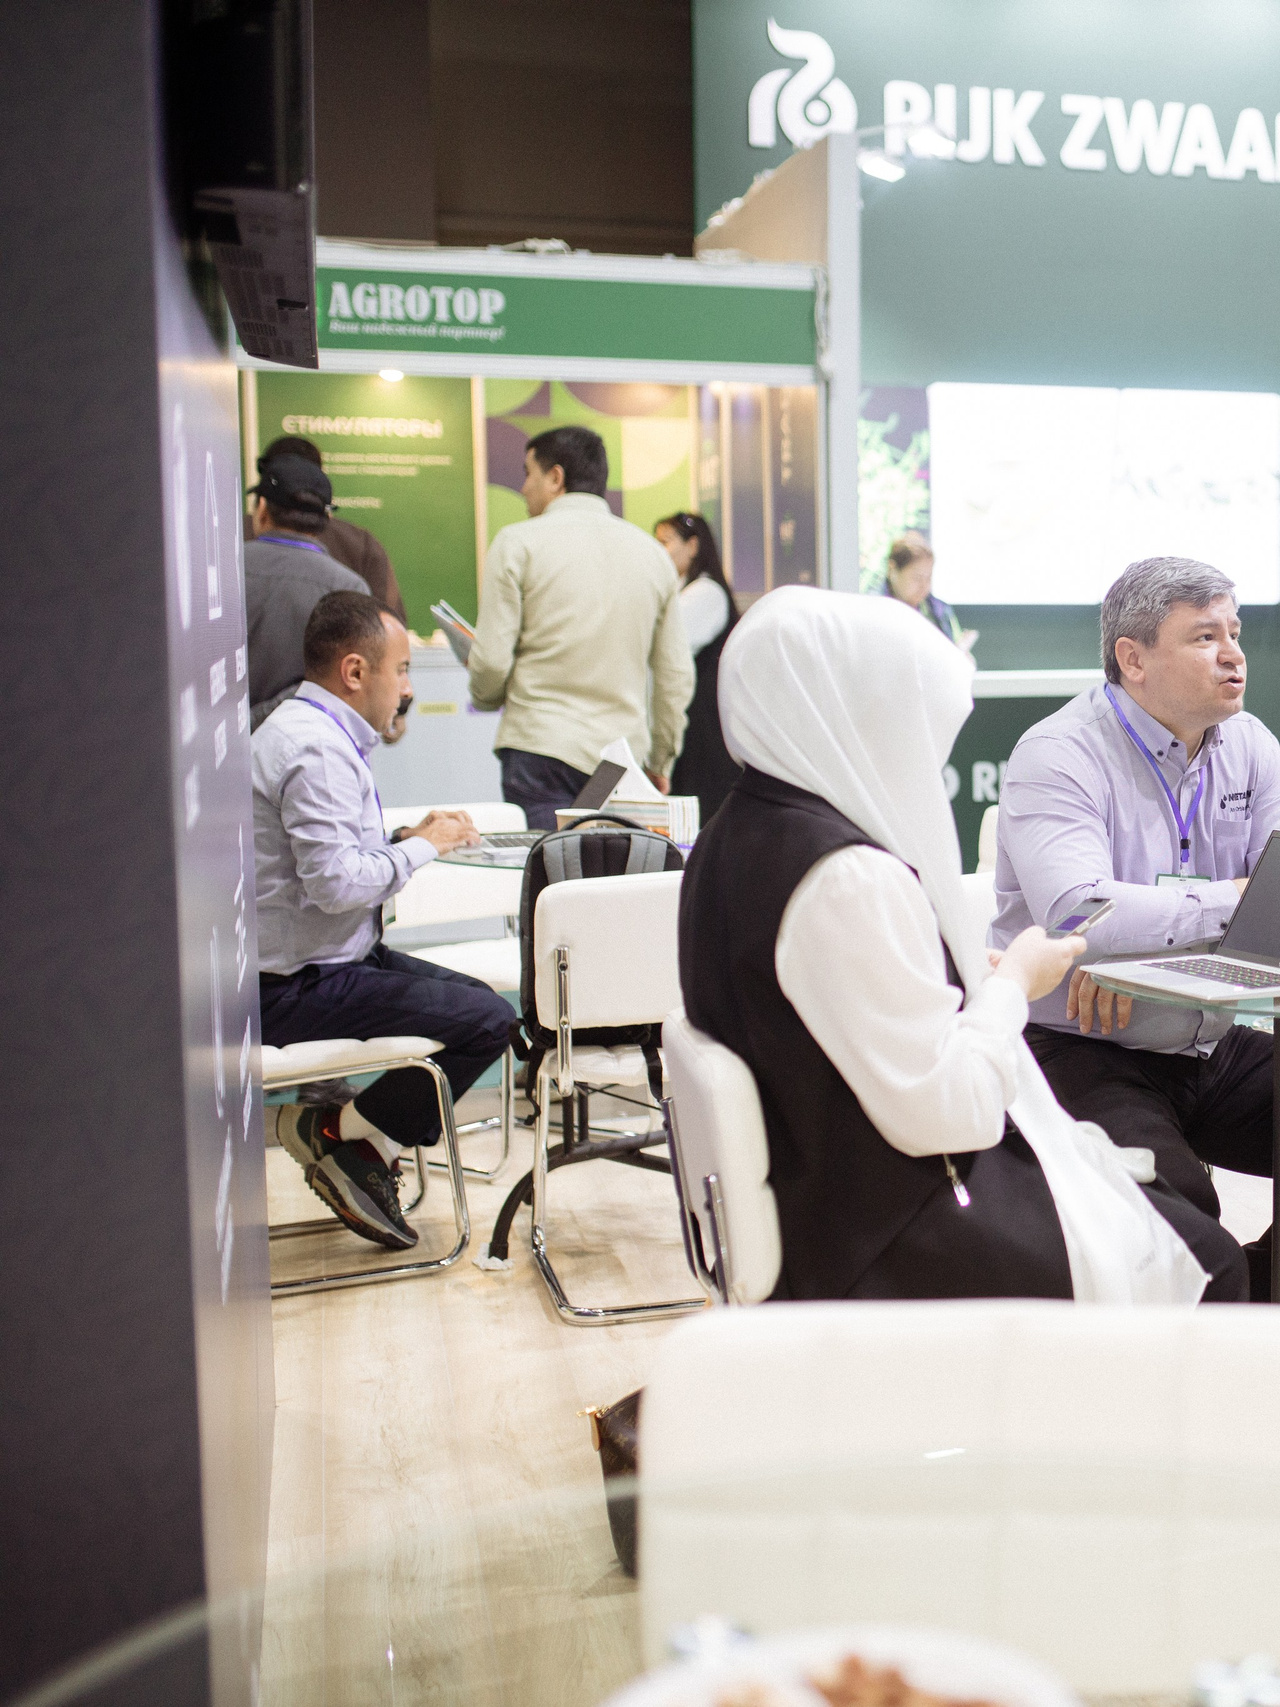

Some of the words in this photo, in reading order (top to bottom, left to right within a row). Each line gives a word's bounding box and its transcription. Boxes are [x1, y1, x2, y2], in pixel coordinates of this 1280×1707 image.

[884, 79, 1047, 167] RIJK
[328, 281, 506, 325] AGROTOP
[282, 414, 443, 439] СТИМУЛЯТОРЫ
